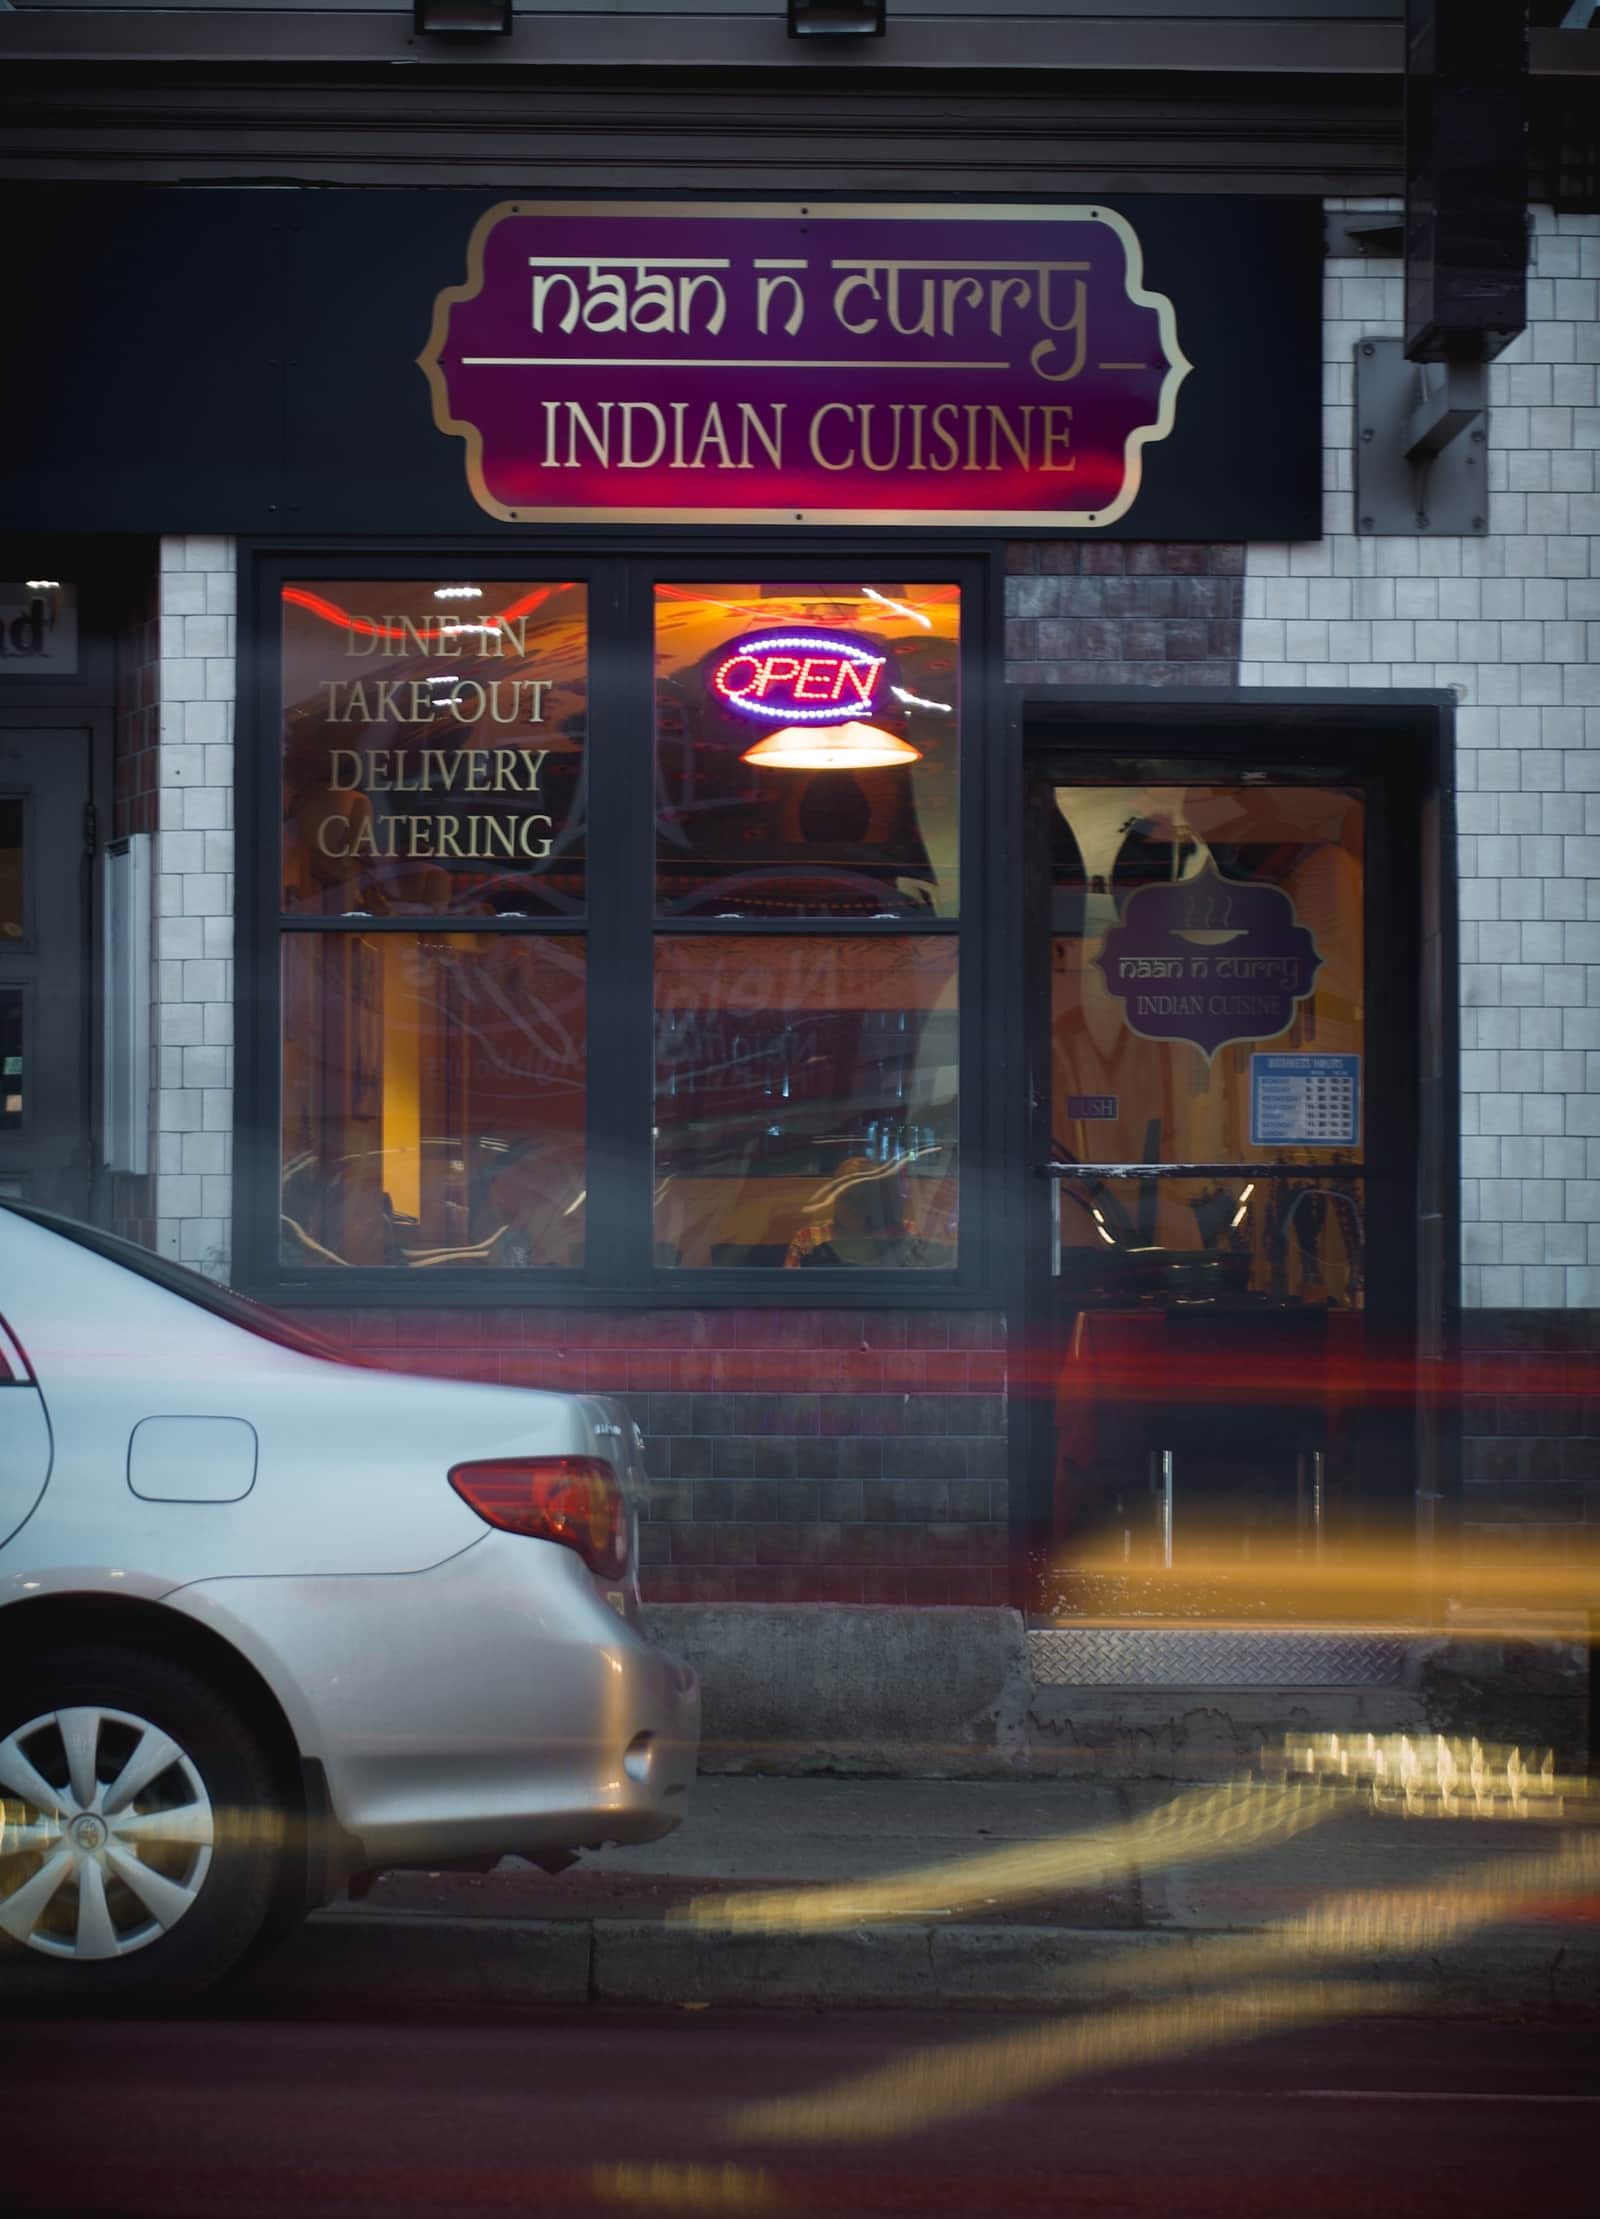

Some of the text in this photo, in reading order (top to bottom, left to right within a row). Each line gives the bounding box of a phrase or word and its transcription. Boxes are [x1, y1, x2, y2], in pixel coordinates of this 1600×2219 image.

[529, 257, 1091, 382] naan n curry
[540, 401, 1077, 471] INDIAN CUISINE
[345, 615, 529, 657] DINE IN
[714, 655, 881, 701] OPEN
[320, 680, 553, 723] TAKE OUT
[328, 749, 549, 791] DELIVERY
[317, 815, 553, 858] CATERING
[1119, 956, 1184, 979] naan
[1215, 956, 1300, 991] curry
[1136, 995, 1281, 1016] INDIAN CUISINE
